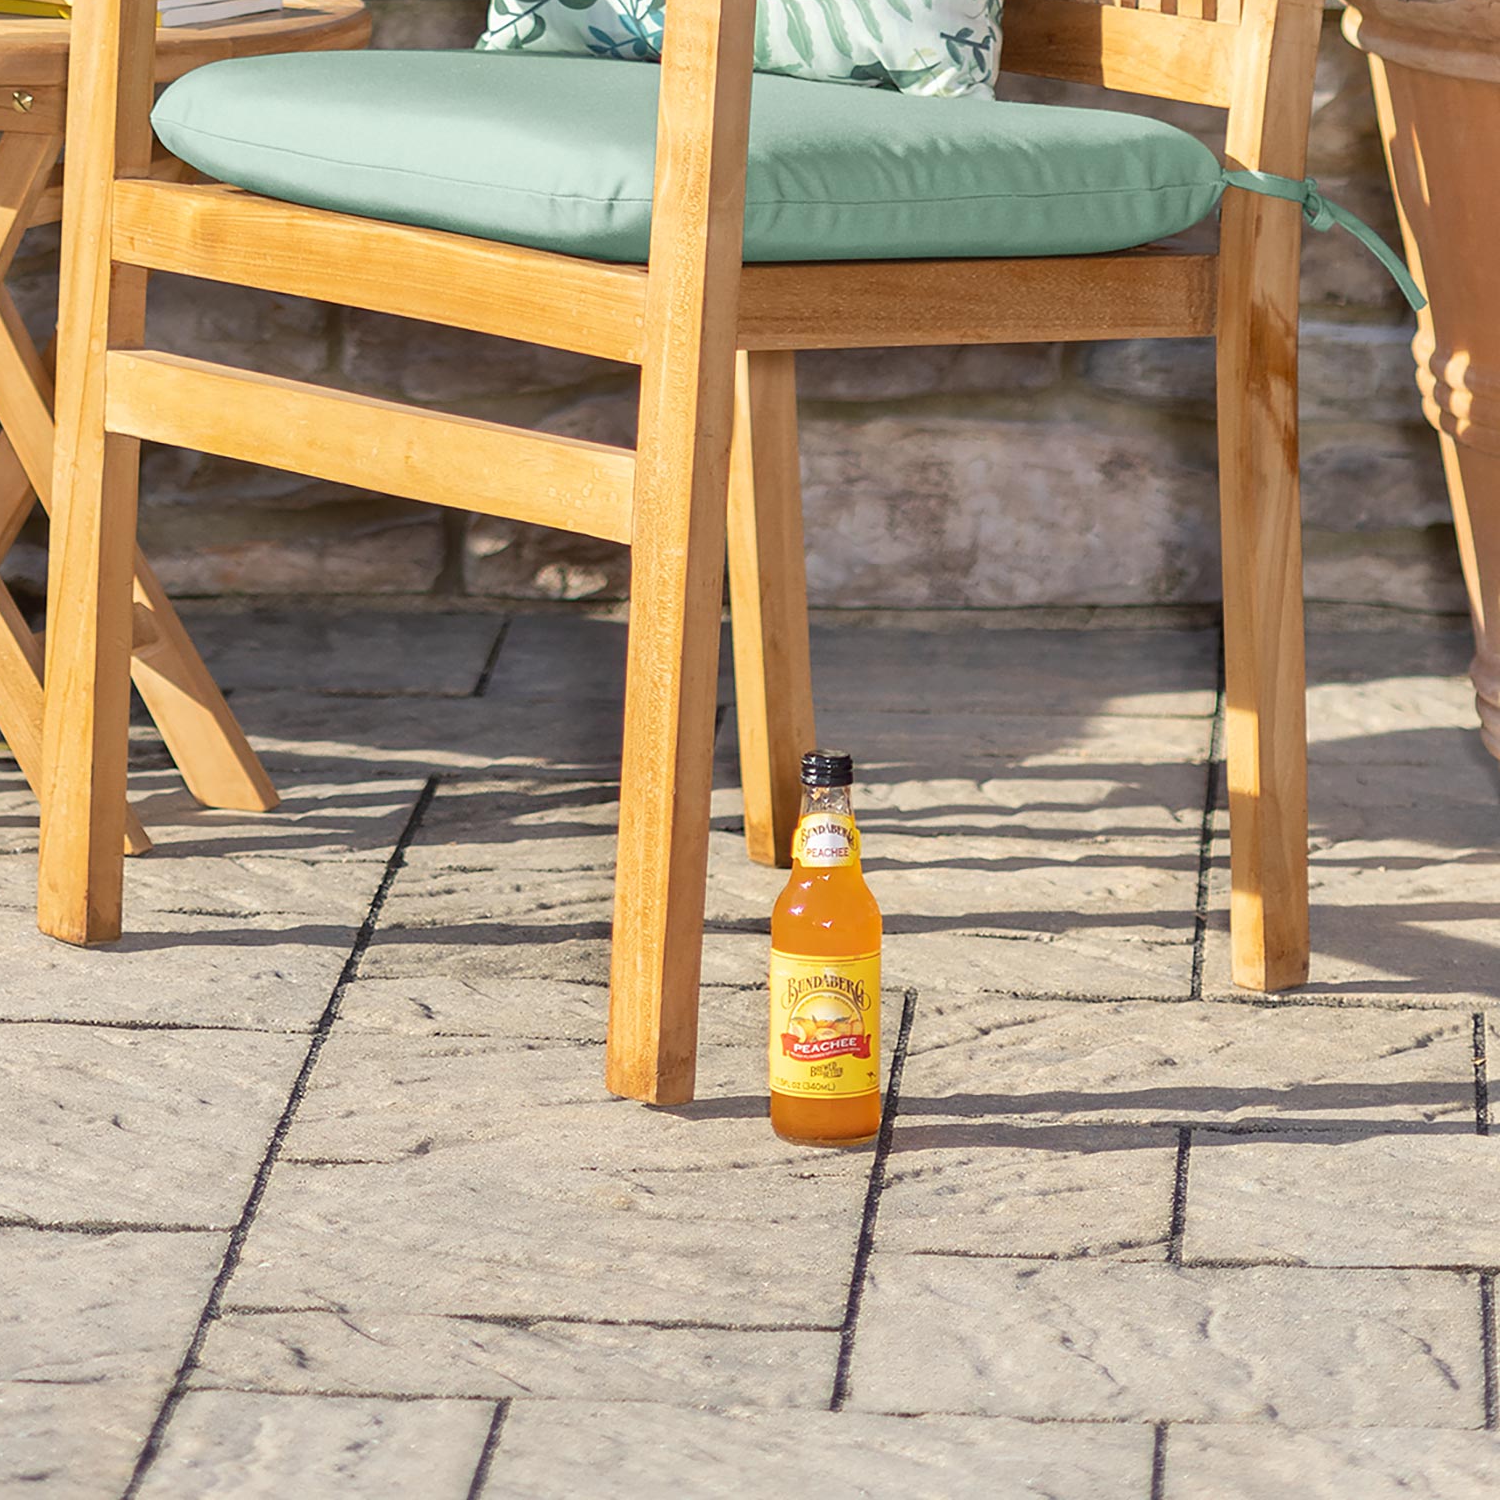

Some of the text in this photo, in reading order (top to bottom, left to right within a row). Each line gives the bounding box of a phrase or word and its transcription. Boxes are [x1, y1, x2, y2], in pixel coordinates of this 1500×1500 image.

[806, 847, 850, 858] PEACHEE
[781, 974, 871, 1011] BUNDABERG
[793, 1037, 857, 1054] PEACHEE
